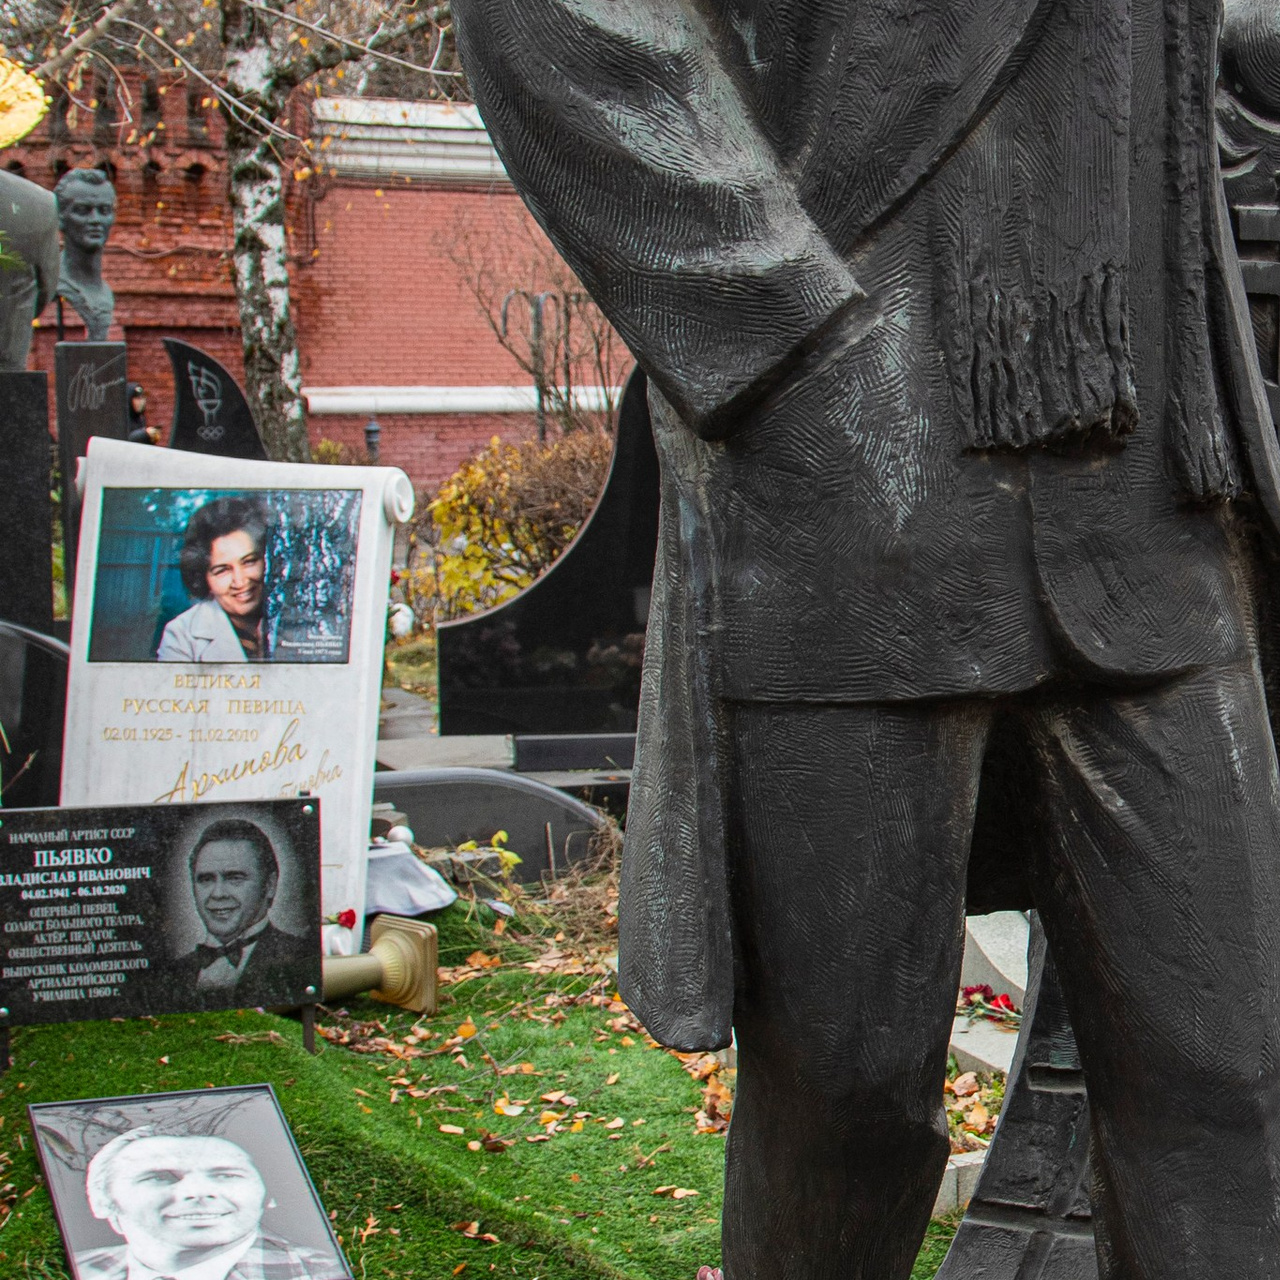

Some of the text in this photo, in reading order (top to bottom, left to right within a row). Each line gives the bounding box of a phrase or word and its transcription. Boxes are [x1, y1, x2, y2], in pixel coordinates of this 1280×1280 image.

[173, 674, 262, 689] ВЕЛИКАЯ
[122, 698, 306, 716] РУССКАЯ ПЕВИЦА
[9, 828, 135, 844] НАРОДНЫЙ АРТИСТ СССР
[34, 847, 113, 866] ПЬЯВКО
[79, 867, 151, 882] ИВАНОВИЧ
[21, 888, 70, 899] 04.02.1941
[77, 885, 127, 897] 06.10.2020
[29, 905, 80, 917] ОПЕРНЫЙ
[8, 941, 142, 959] ОБЩЕСТВЕННЫЙ ДЕЯТЕЛЬ
[3, 959, 149, 977] ВЫПУСКНИК КОЛОМЕНСКОГО
